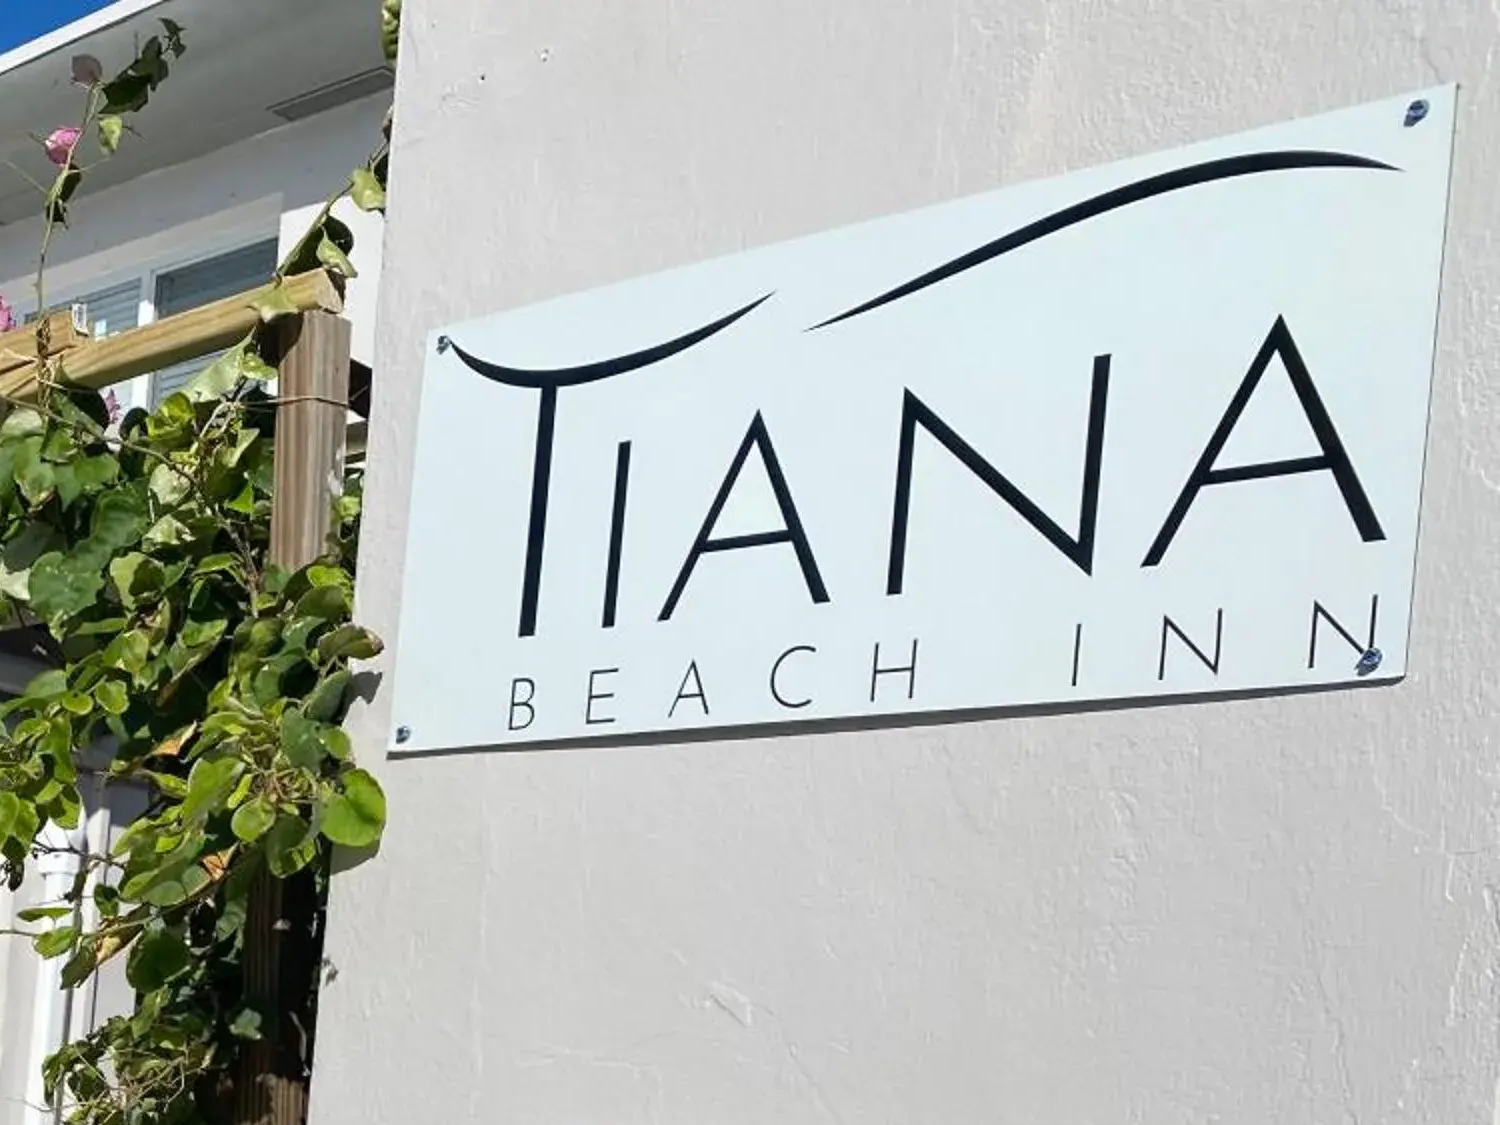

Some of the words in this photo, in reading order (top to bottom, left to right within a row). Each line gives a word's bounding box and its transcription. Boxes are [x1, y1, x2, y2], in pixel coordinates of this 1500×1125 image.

[447, 289, 1388, 638] TIANA
[506, 636, 920, 732] BEACH
[1069, 593, 1380, 688] INN
